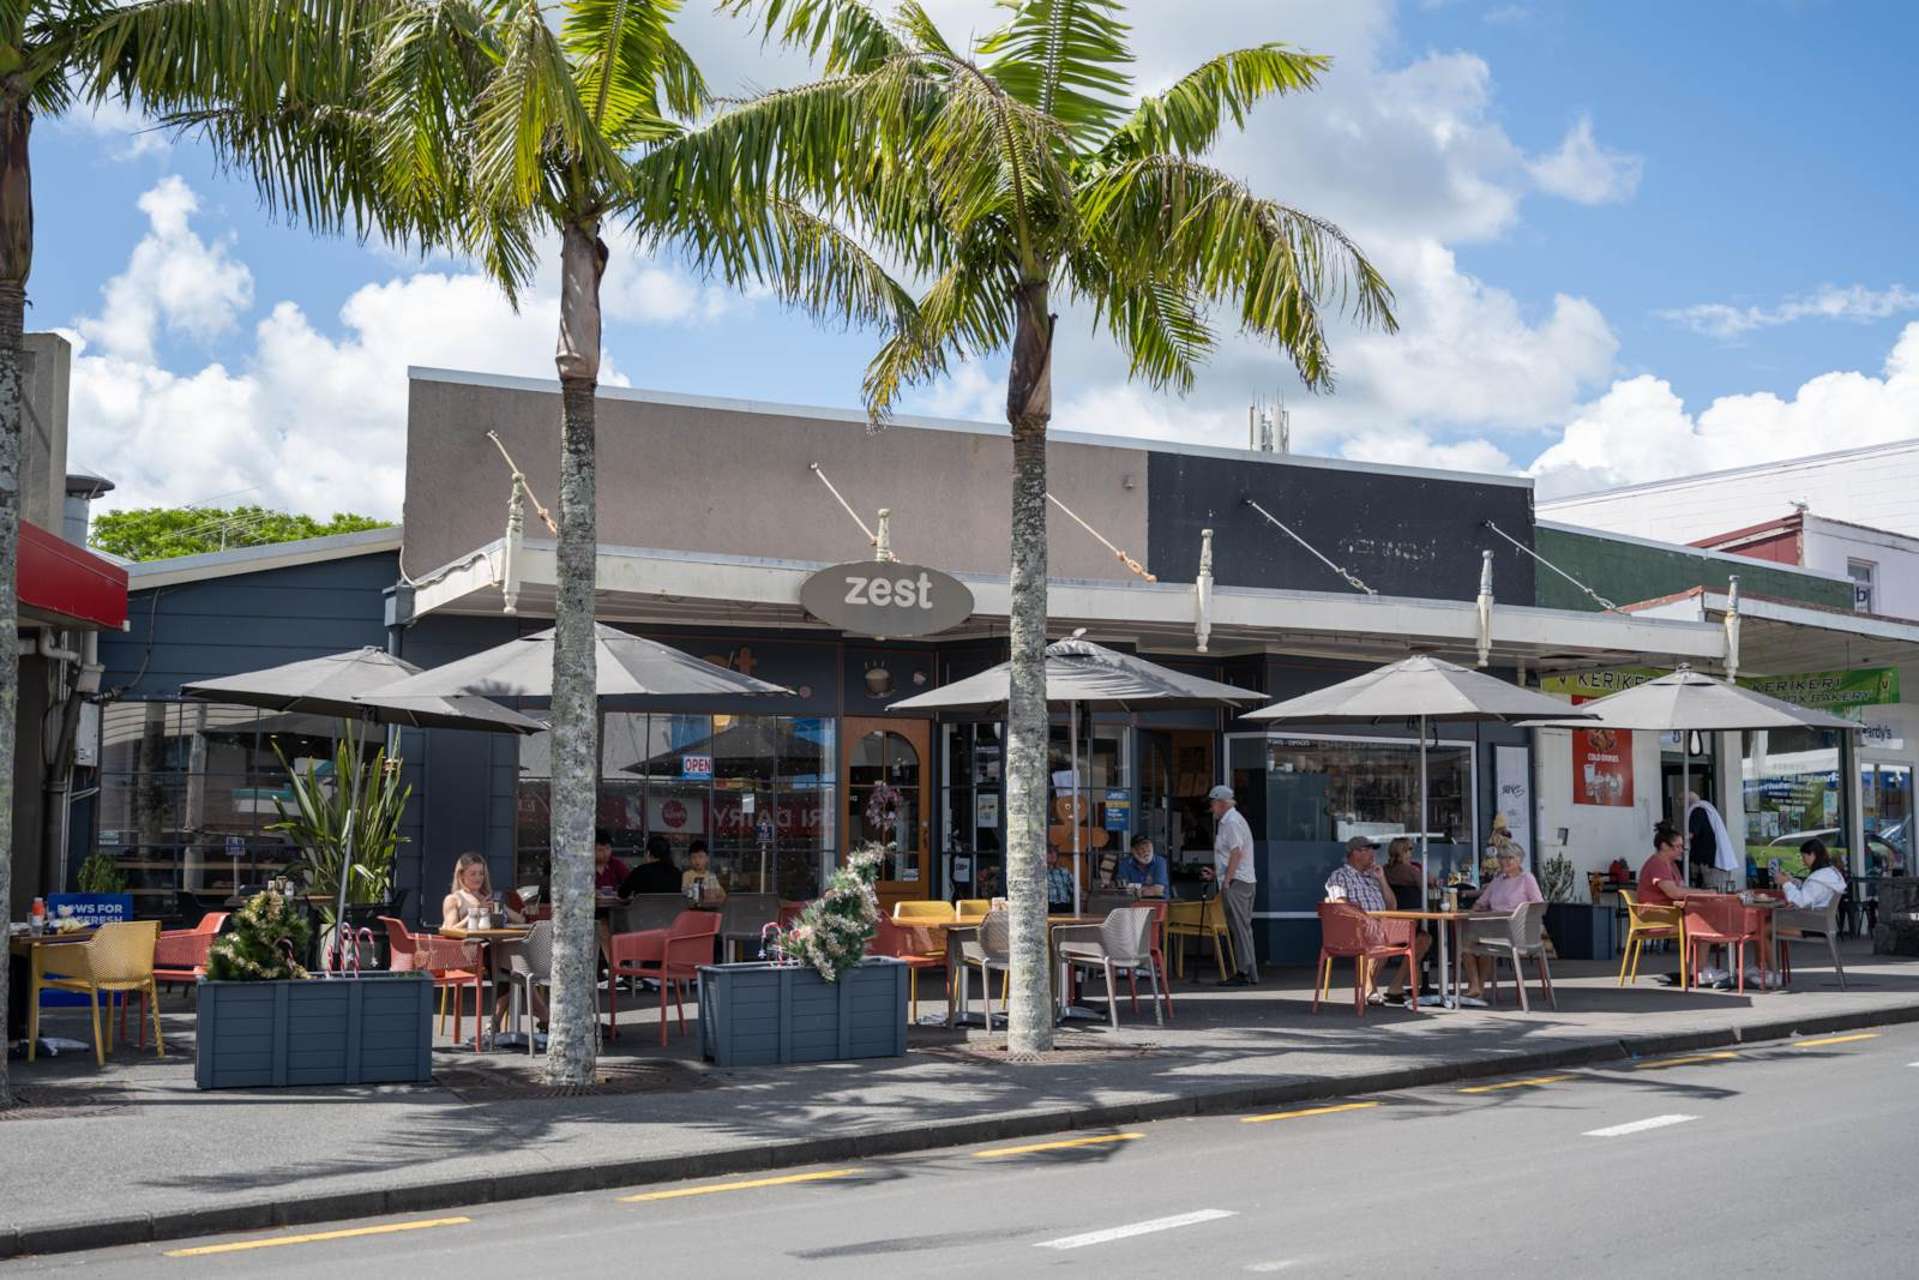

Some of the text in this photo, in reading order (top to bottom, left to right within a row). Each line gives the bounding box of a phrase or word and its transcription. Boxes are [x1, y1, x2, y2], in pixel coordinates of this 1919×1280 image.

[844, 572, 933, 610] zest
[685, 757, 711, 772] OPEN
[97, 904, 123, 914] FOR
